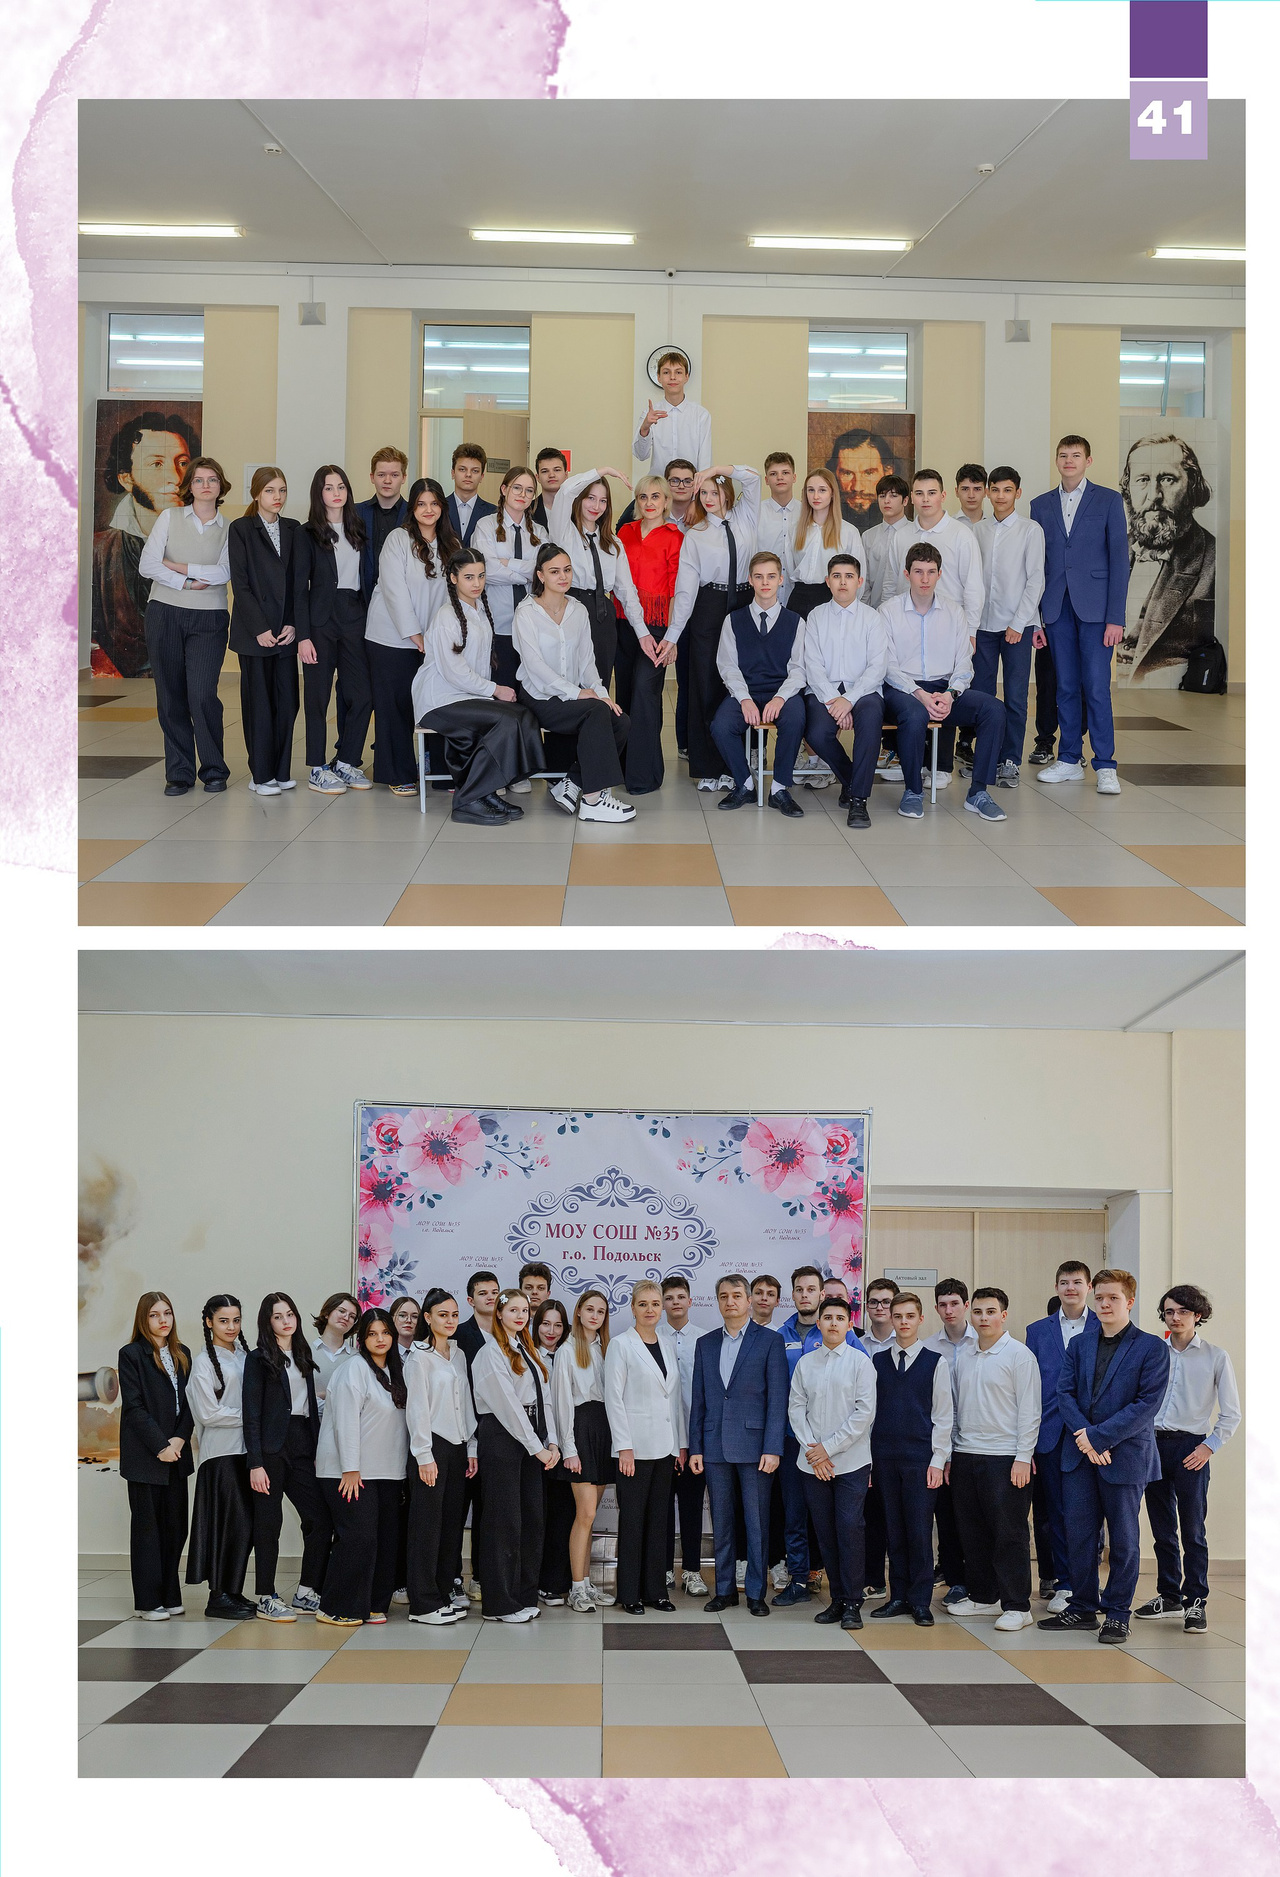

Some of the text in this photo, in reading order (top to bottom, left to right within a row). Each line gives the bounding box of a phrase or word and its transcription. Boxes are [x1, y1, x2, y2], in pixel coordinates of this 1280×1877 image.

[545, 1223, 680, 1241] МОУ СОШ №35
[562, 1246, 662, 1263] г.о. Подольск
